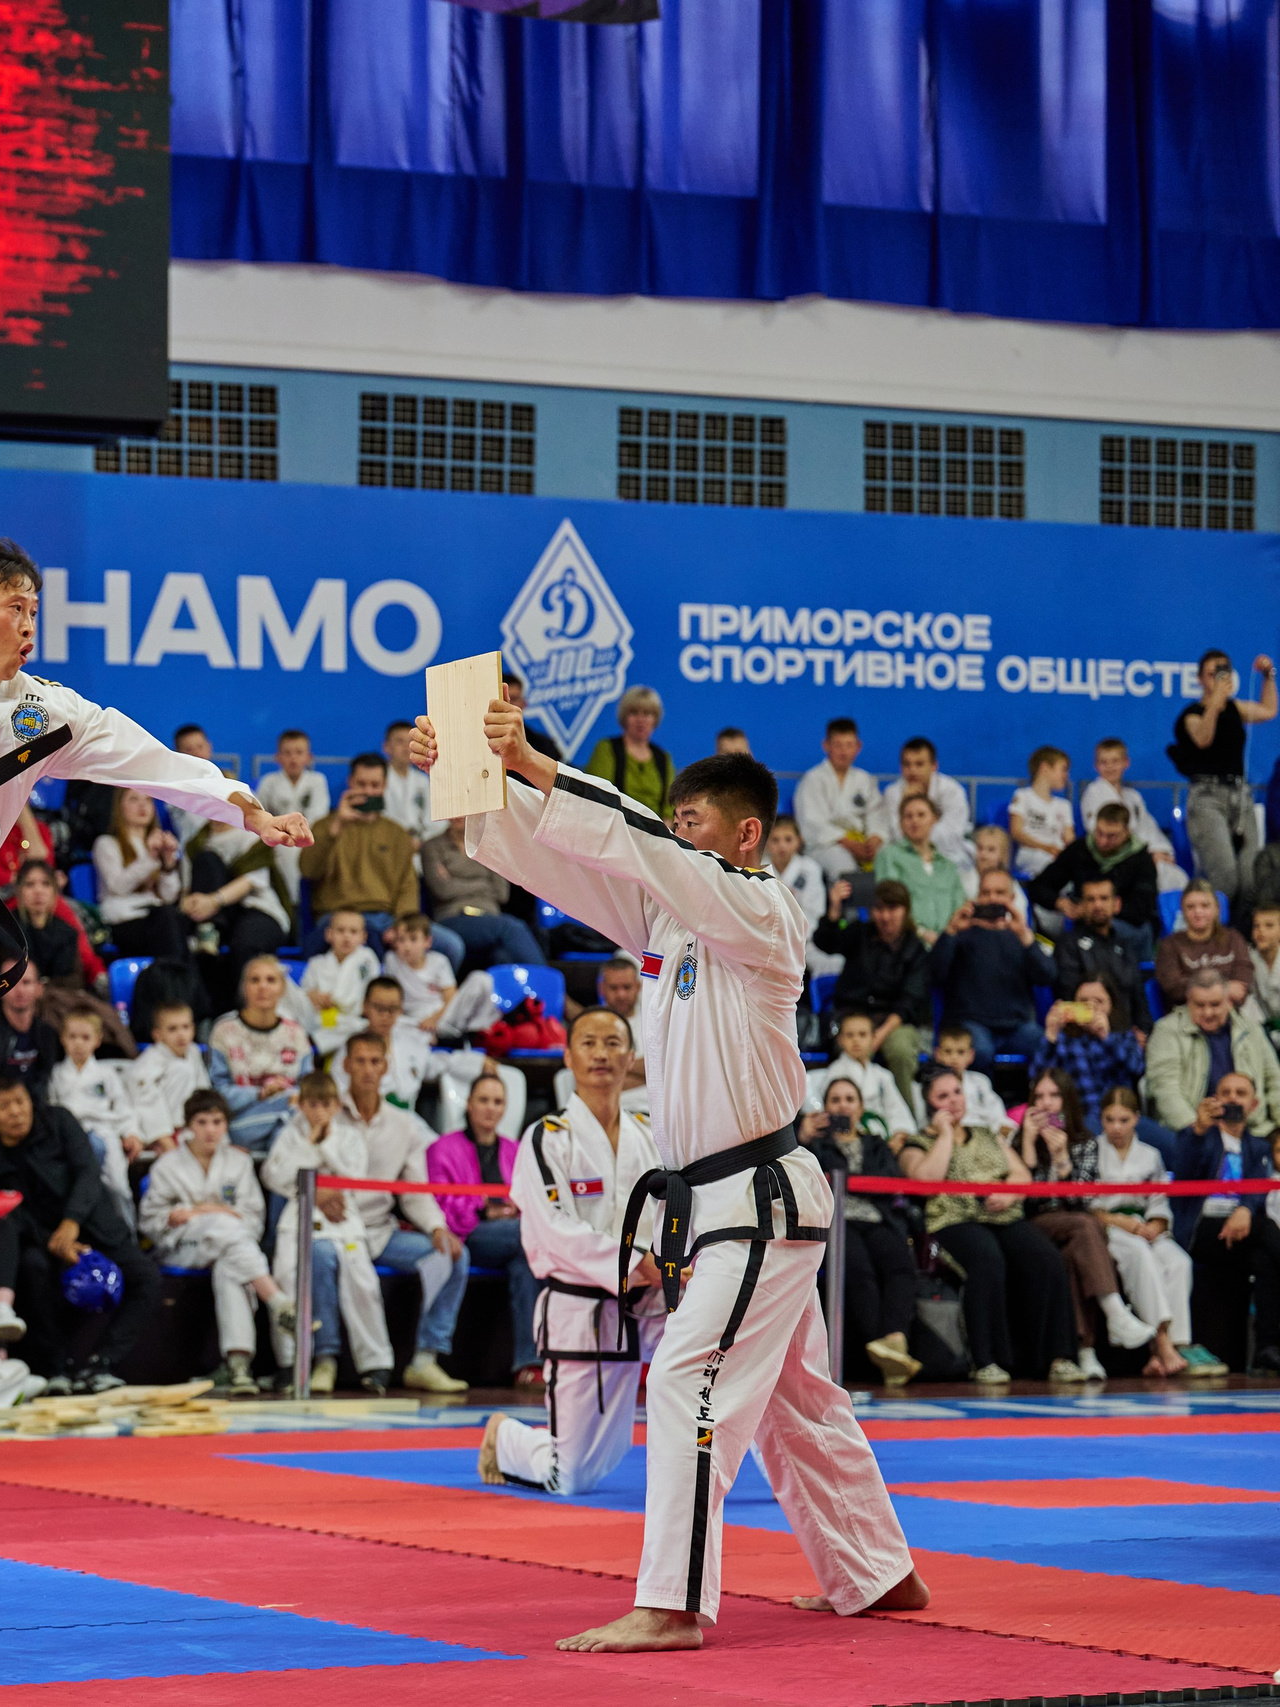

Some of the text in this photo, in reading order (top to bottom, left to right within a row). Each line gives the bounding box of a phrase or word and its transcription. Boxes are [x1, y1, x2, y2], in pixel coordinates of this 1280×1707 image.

[679, 603, 992, 651] ПРИМОРСКОЕ
[679, 643, 1240, 700] СПОРТИВНОЕ ОБЩЕСТВ
[25, 693, 45, 703] ITF
[707, 1350, 726, 1365] ITF
